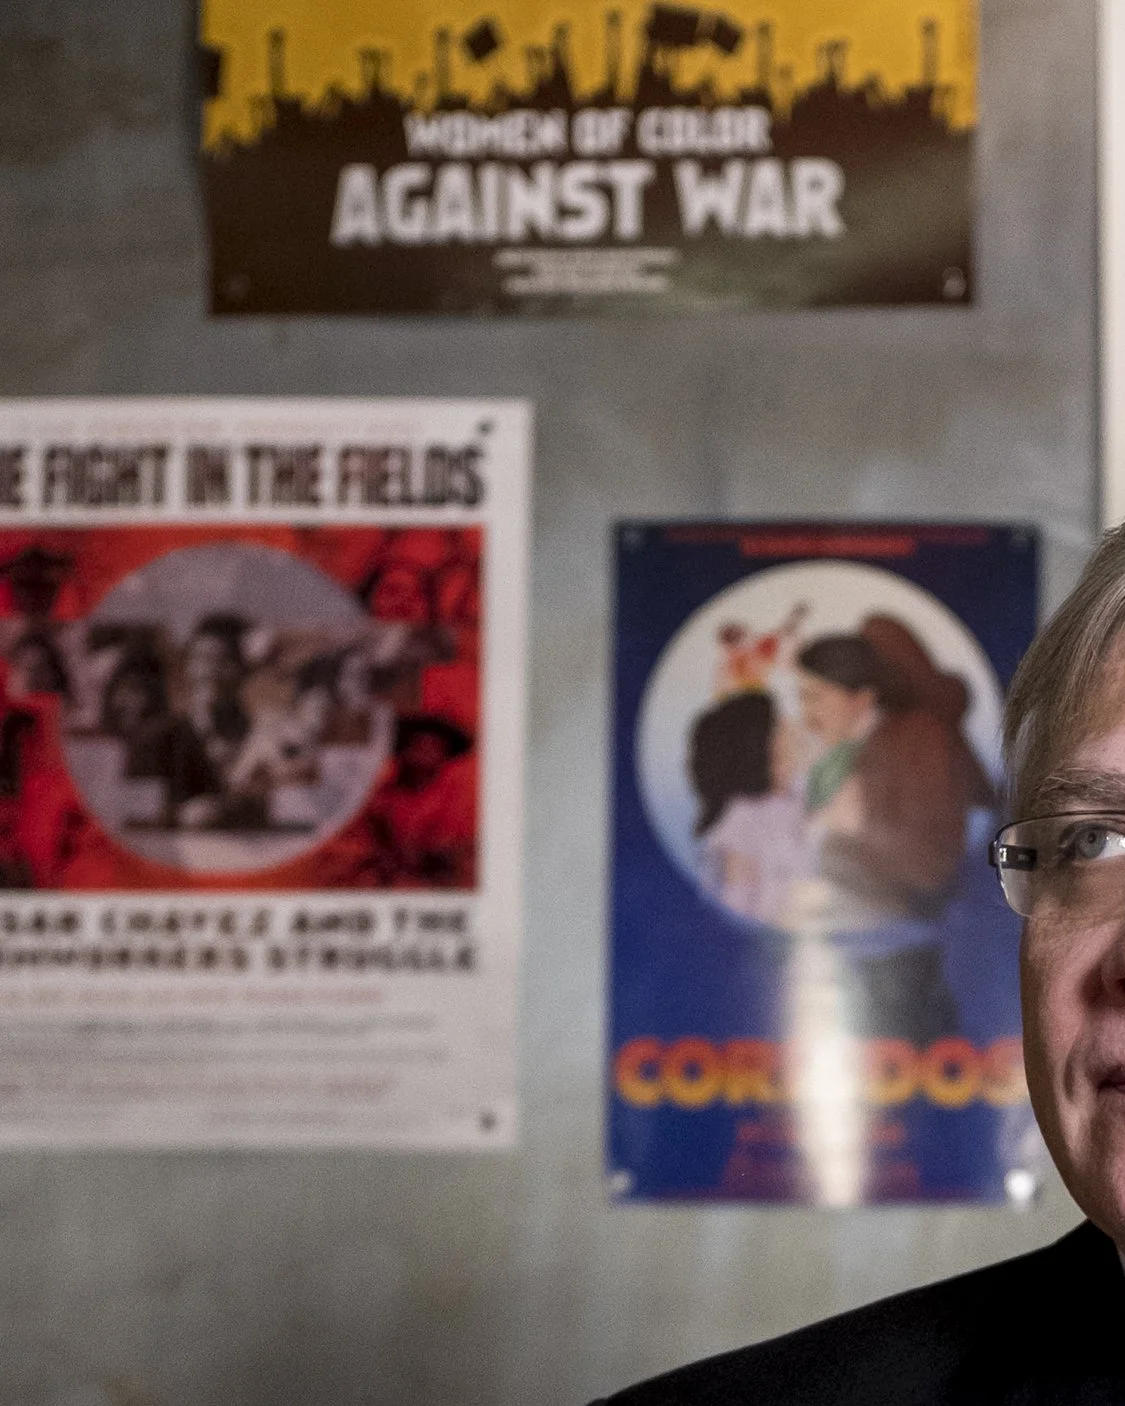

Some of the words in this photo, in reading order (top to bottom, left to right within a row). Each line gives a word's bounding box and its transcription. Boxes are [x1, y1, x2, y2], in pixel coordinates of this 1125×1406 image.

[404, 110, 566, 158] WOMEN
[573, 109, 634, 156] OF
[637, 107, 771, 154] COLOR
[330, 162, 655, 245] AGAINST
[673, 158, 848, 238] WAR
[44, 443, 168, 508] FIGHT
[186, 443, 231, 508] IN
[247, 443, 322, 506] THE
[338, 443, 485, 506] FIELDS
[292, 908, 375, 933] AND
[394, 908, 468, 933] THE
